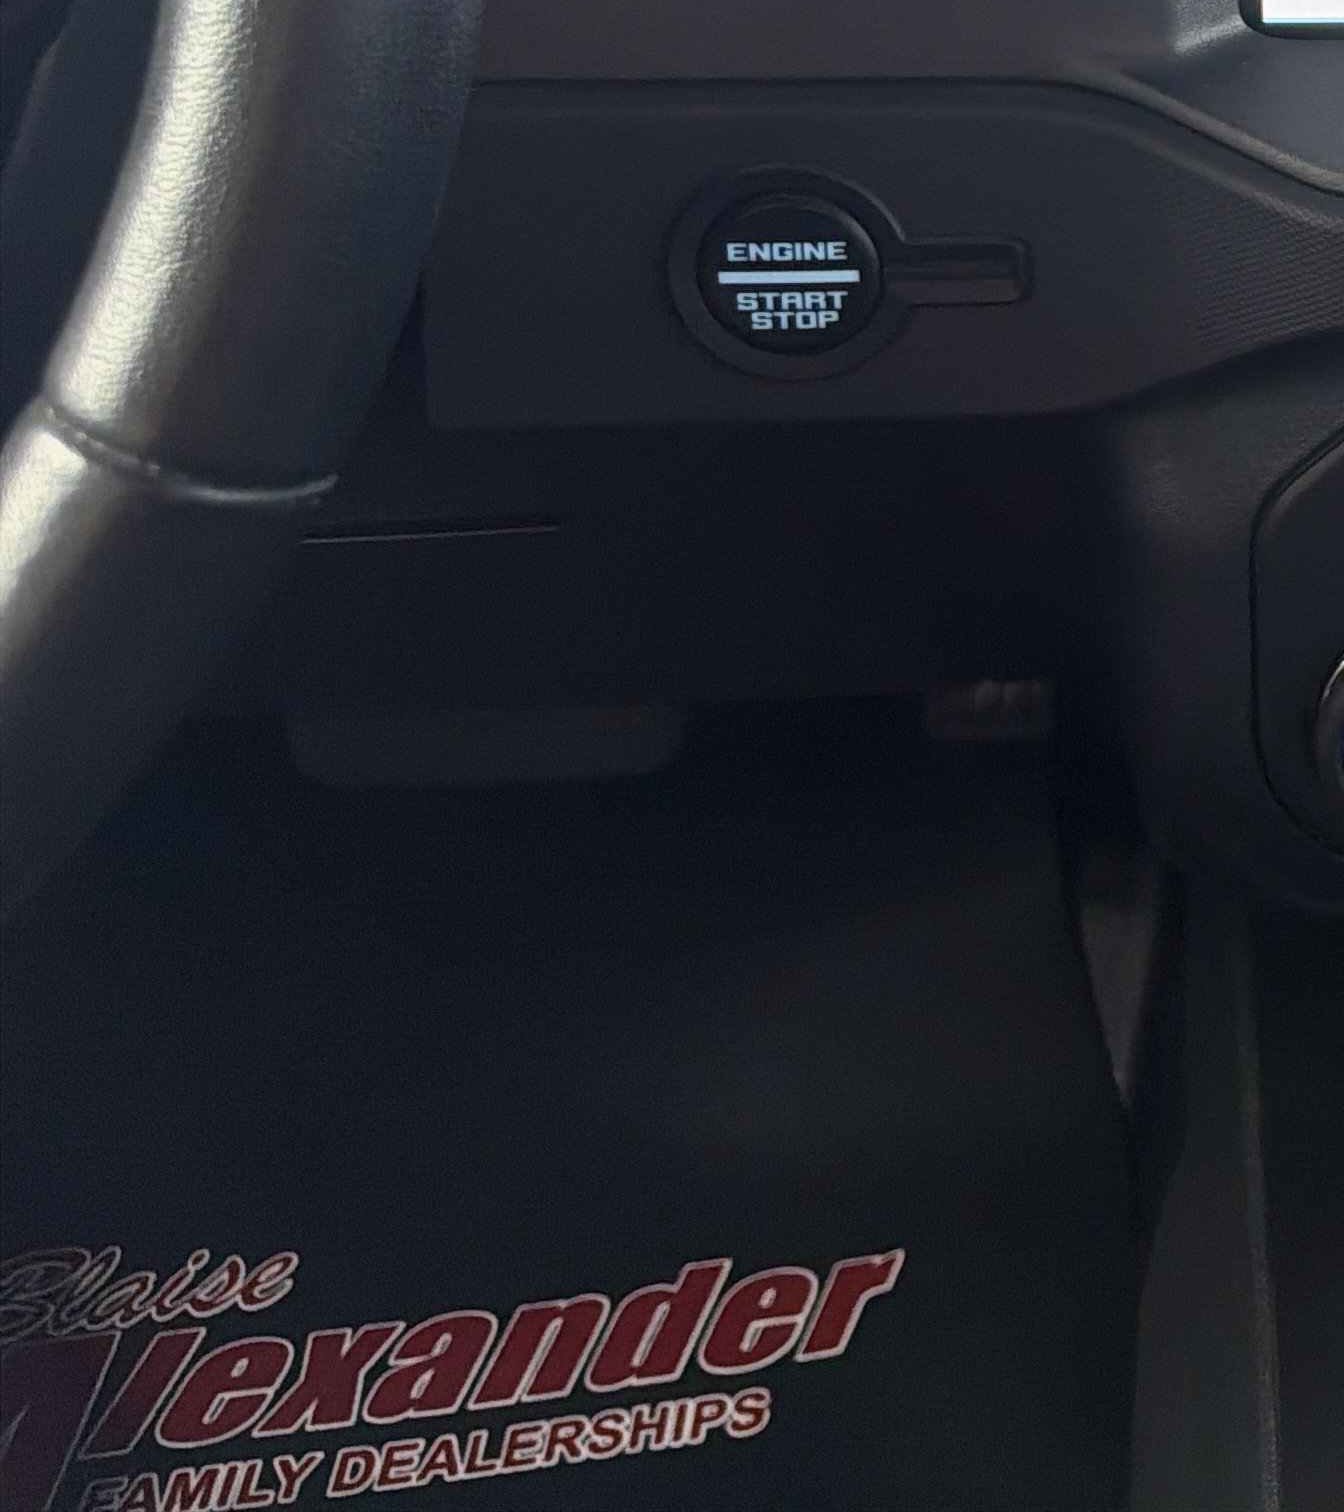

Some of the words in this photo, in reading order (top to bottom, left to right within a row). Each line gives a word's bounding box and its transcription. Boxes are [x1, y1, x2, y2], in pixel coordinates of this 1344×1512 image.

[726, 241, 848, 262] ENGINE
[737, 290, 848, 310] START
[751, 311, 839, 330] STOP
[80, 1451, 320, 1511] FAMILY
[326, 1386, 772, 1498] DEALERSHIPS
